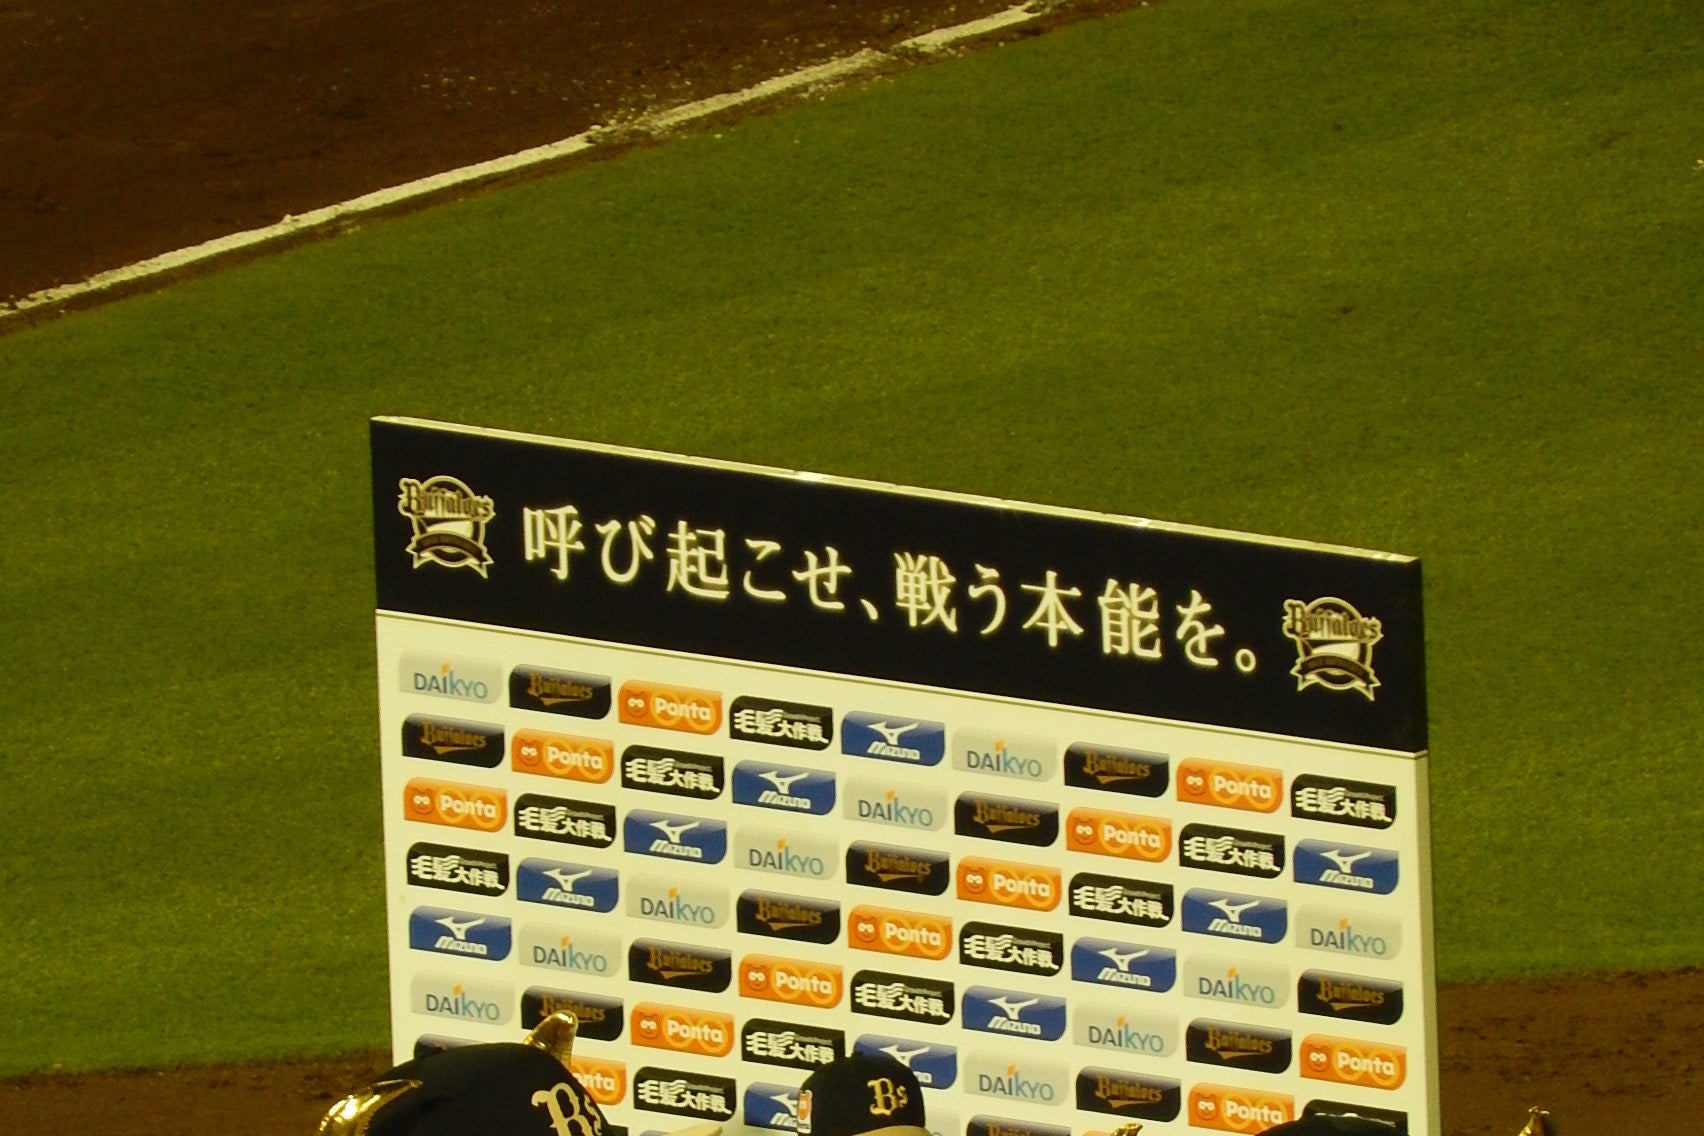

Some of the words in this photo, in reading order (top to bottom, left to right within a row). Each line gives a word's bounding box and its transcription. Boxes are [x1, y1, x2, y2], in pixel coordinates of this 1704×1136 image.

[403, 480, 491, 518] Buffaloes
[522, 503, 1256, 673] 呼び起こせ、戦う本能を。
[1287, 600, 1378, 640] Buffaloes
[526, 672, 594, 704] Buffaloes
[653, 696, 711, 722] Ponta
[419, 720, 487, 753] Buffaloes
[734, 708, 828, 745] 毛髪大作戦
[546, 745, 603, 771] Ponta
[1082, 749, 1152, 782] Buffaloes
[626, 757, 719, 794] 毛髪大作戦
[1212, 774, 1272, 800] Ponta
[439, 794, 496, 820] Ponta
[972, 798, 1041, 831] Buffaloes
[1295, 786, 1391, 823] 毛髪大作戦
[518, 806, 611, 843] 毛髪大作戦
[1102, 824, 1161, 850] Ponta
[863, 847, 932, 880] Buffaloes
[1184, 836, 1279, 873] 毛髪大作戦
[411, 855, 503, 891] 毛髪大作戦
[992, 873, 1050, 899] Ponta
[754, 896, 822, 929] Buffaloes
[1073, 885, 1168, 922] 毛髪大作戦
[882, 922, 941, 947] Ponta
[646, 944, 714, 978] Buffaloes
[964, 934, 1058, 971] 毛髪大作戦
[773, 970, 831, 996] Ponta
[1315, 976, 1385, 1010] Buffaloes
[854, 982, 948, 1019] 毛髪大作戦
[665, 1018, 723, 1044] Ponta
[1204, 1025, 1274, 1059] Buffaloes
[1335, 1051, 1394, 1078] Ponta
[637, 1079, 731, 1116] 毛髪大作戦
[866, 1077, 908, 1118] Bs
[1093, 1074, 1163, 1108] Buffaloes
[1224, 1100, 1283, 1126] Ponta
